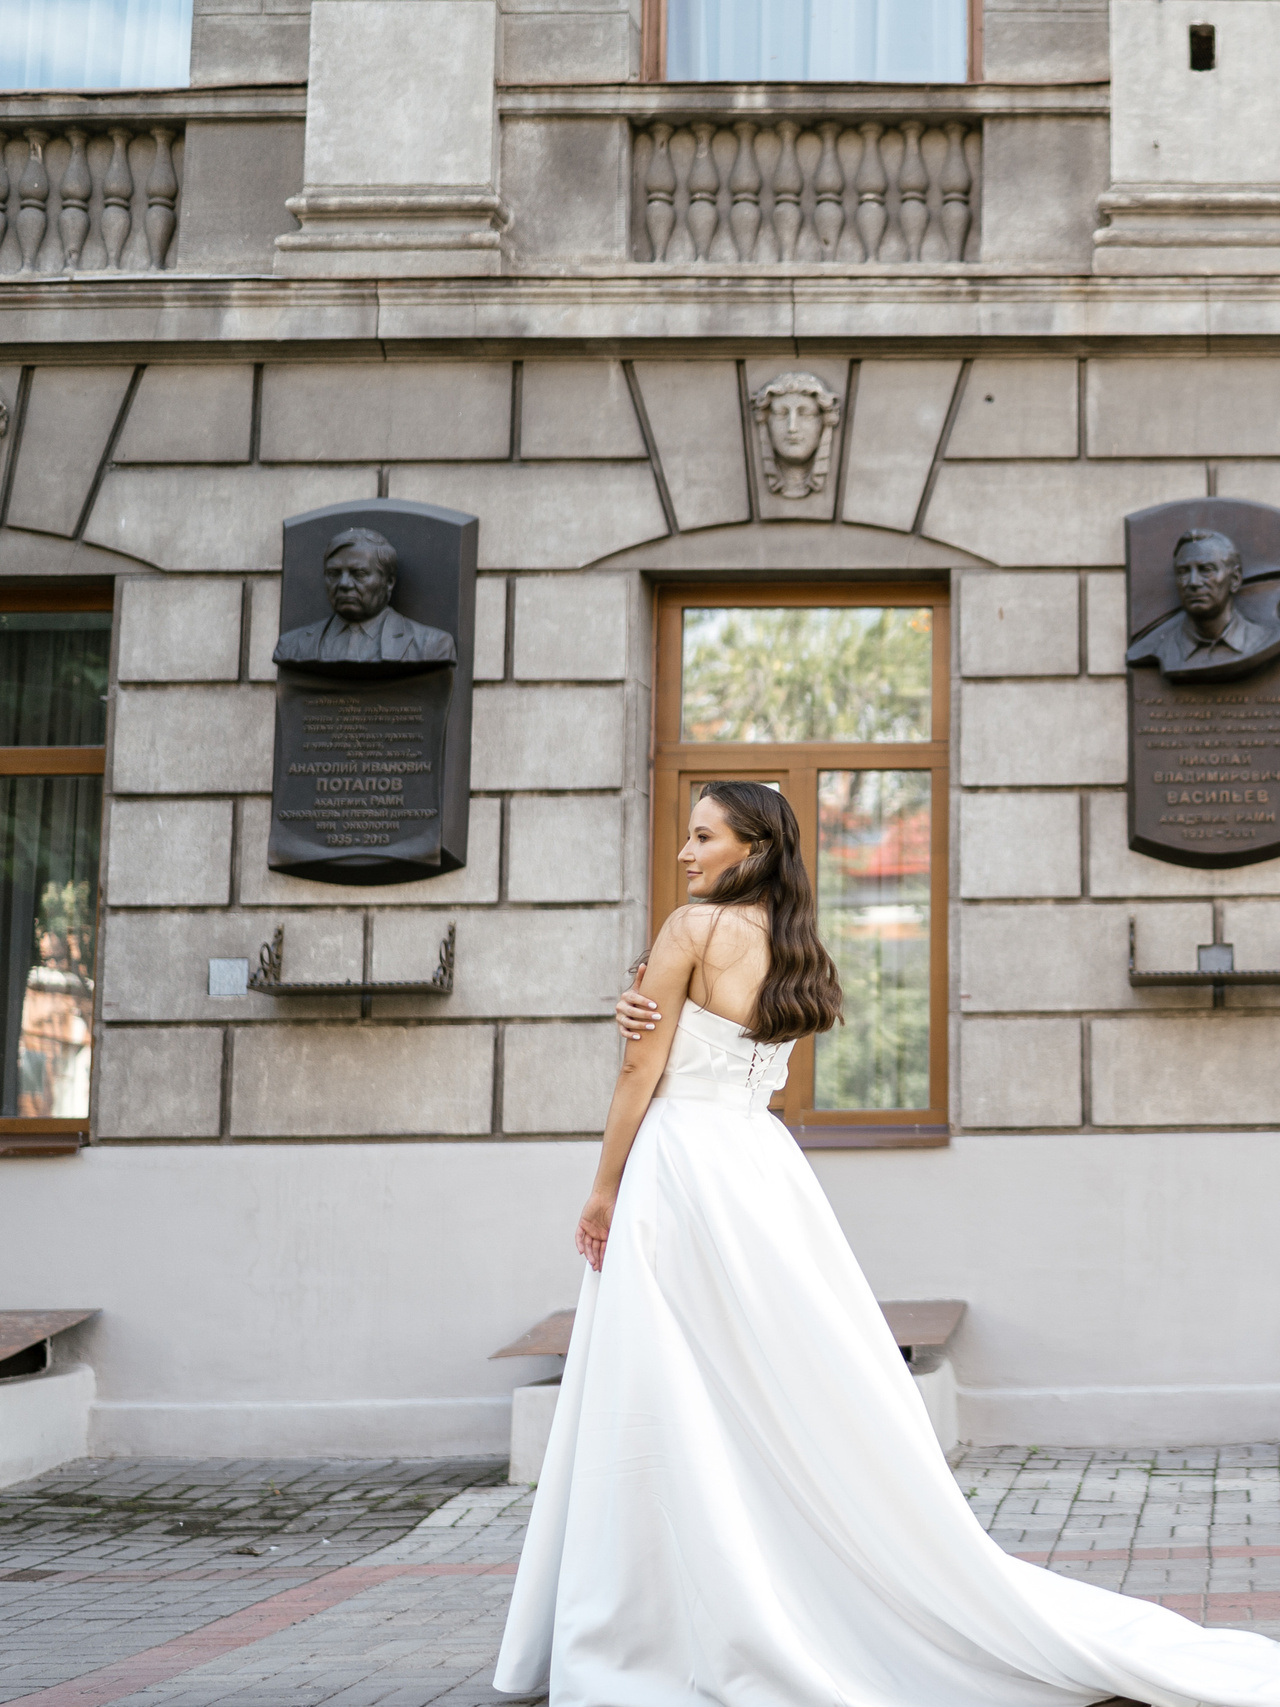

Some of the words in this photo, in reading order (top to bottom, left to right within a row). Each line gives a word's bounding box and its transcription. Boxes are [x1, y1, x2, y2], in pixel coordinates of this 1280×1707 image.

[1178, 752, 1252, 766] НИКОЛАЙ
[288, 759, 358, 774] АНАТОЛИЙ
[361, 761, 432, 773] ИВАНОВИЧ
[315, 777, 404, 792] ПОТАПОВ
[313, 797, 368, 807] АКАДЕМИК
[370, 794, 405, 807] РАМН
[1166, 789, 1270, 804] ВАСИЛЬЕВ
[278, 809, 341, 819] ОСНОВАТЕЛЬ
[350, 807, 388, 818] ПЕРВЫЙ
[389, 808, 439, 819] ДИРЕКТОР
[1159, 812, 1229, 825] АКАДЕМИК
[1235, 811, 1277, 823] РАМН
[342, 820, 400, 830] ОНКОЛОГИИ
[326, 833, 352, 845] 1935
[363, 833, 390, 845] 2013
